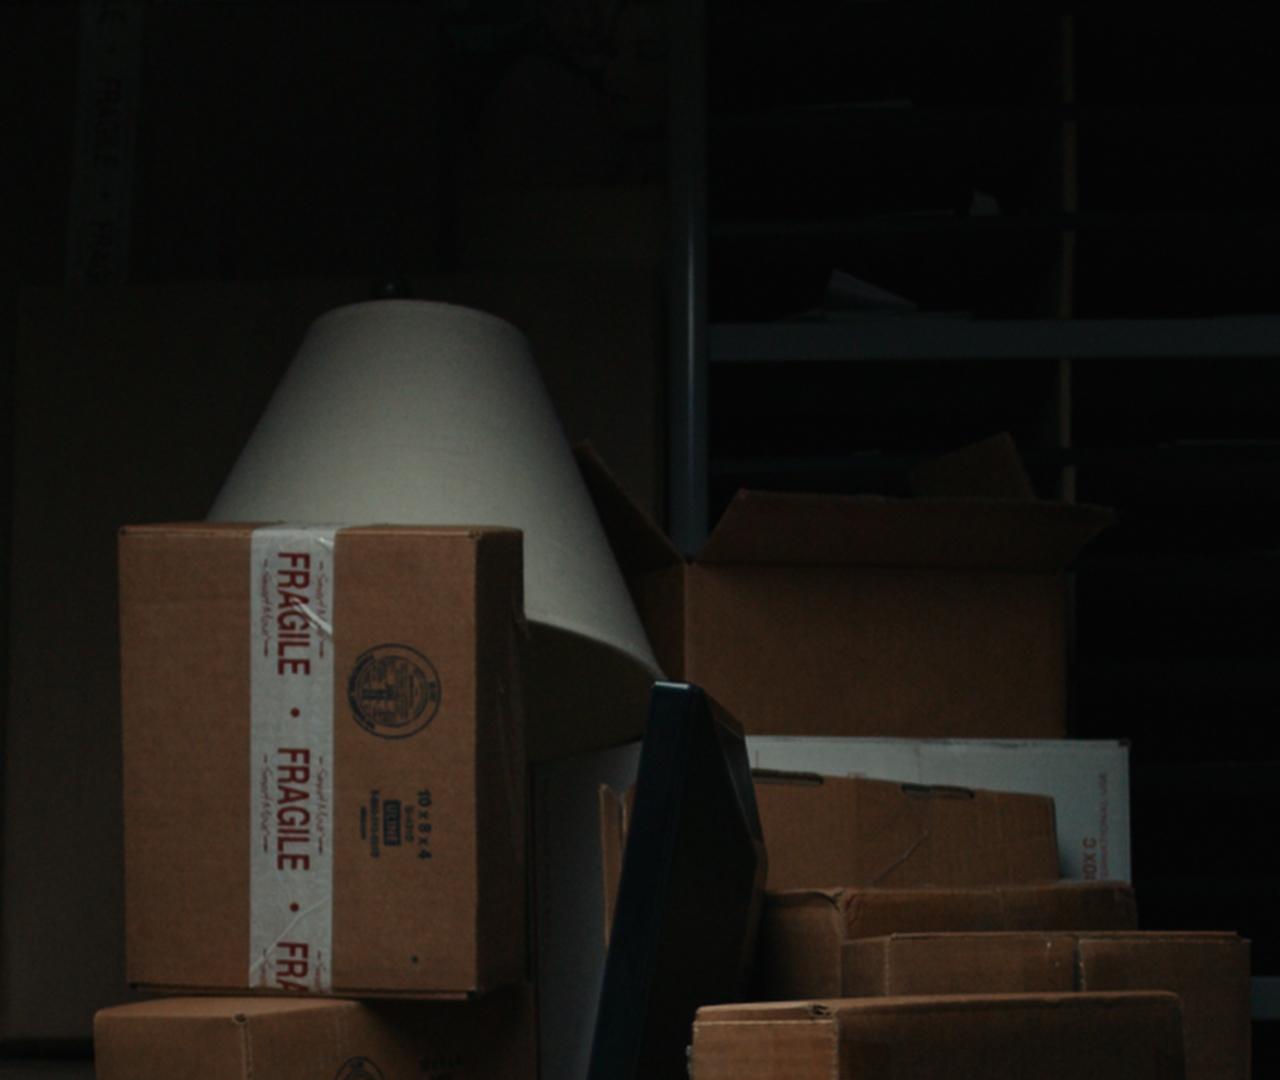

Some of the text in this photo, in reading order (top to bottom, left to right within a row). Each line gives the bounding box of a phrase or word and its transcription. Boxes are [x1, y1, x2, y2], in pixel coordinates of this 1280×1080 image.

[277, 552, 311, 676] FRAGILE
[417, 789, 432, 807] 10
[276, 747, 310, 871] FRAGILE
[417, 822, 432, 834] 8
[1081, 836, 1097, 849] C
[417, 849, 432, 860] 4
